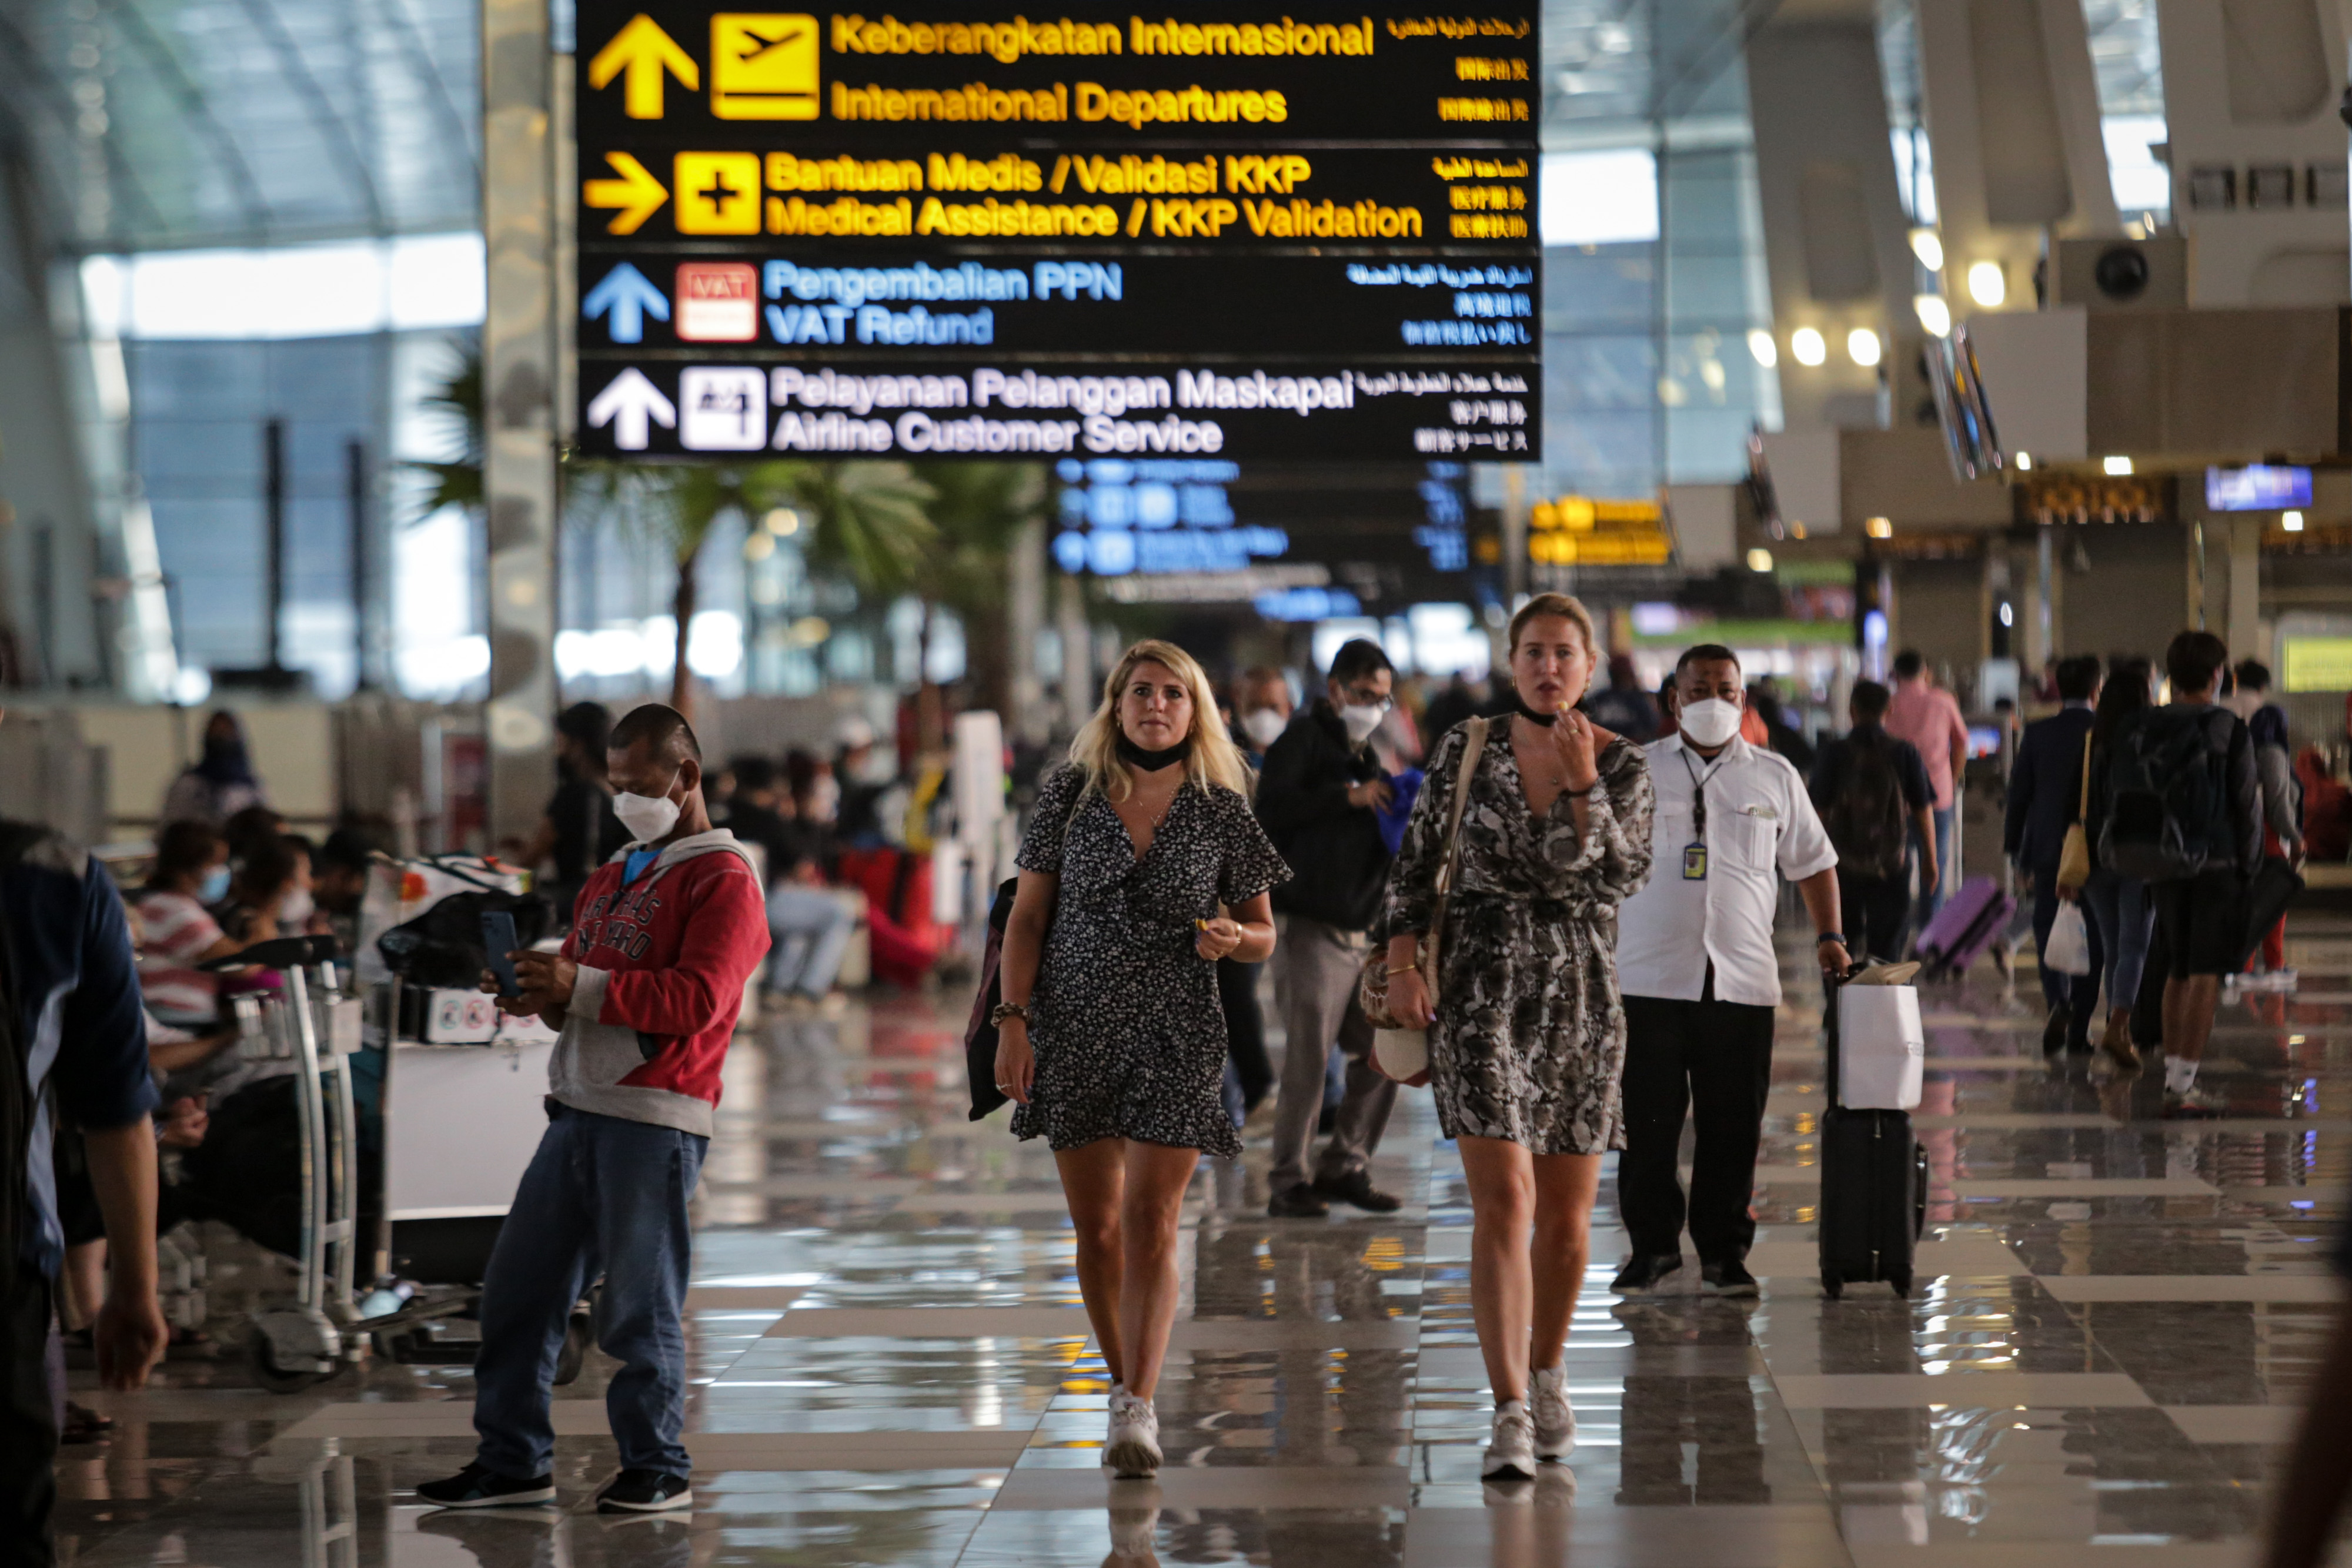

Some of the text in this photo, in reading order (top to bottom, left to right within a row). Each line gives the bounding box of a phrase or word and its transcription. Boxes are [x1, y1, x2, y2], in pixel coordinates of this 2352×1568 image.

[831, 15, 1122, 63] Keberangkatan
[1130, 16, 1374, 55] Internasional
[831, 82, 1288, 130] International Departures
[765, 152, 923, 192] Bantuan
[928, 153, 1043, 192] Medis
[1225, 155, 1311, 193] KKP
[766, 196, 912, 236] Medical
[915, 196, 1119, 236] Assistance
[1242, 198, 1422, 238] Validation
[764, 259, 1122, 309] Pengembalian PPN
[765, 305, 994, 345] VAT Refund
[770, 367, 968, 415] Pelayanan
[973, 368, 1171, 416] Pelanggan
[1177, 369, 1354, 416] Maskapai
[773, 412, 1223, 453] Airline Customer Service
